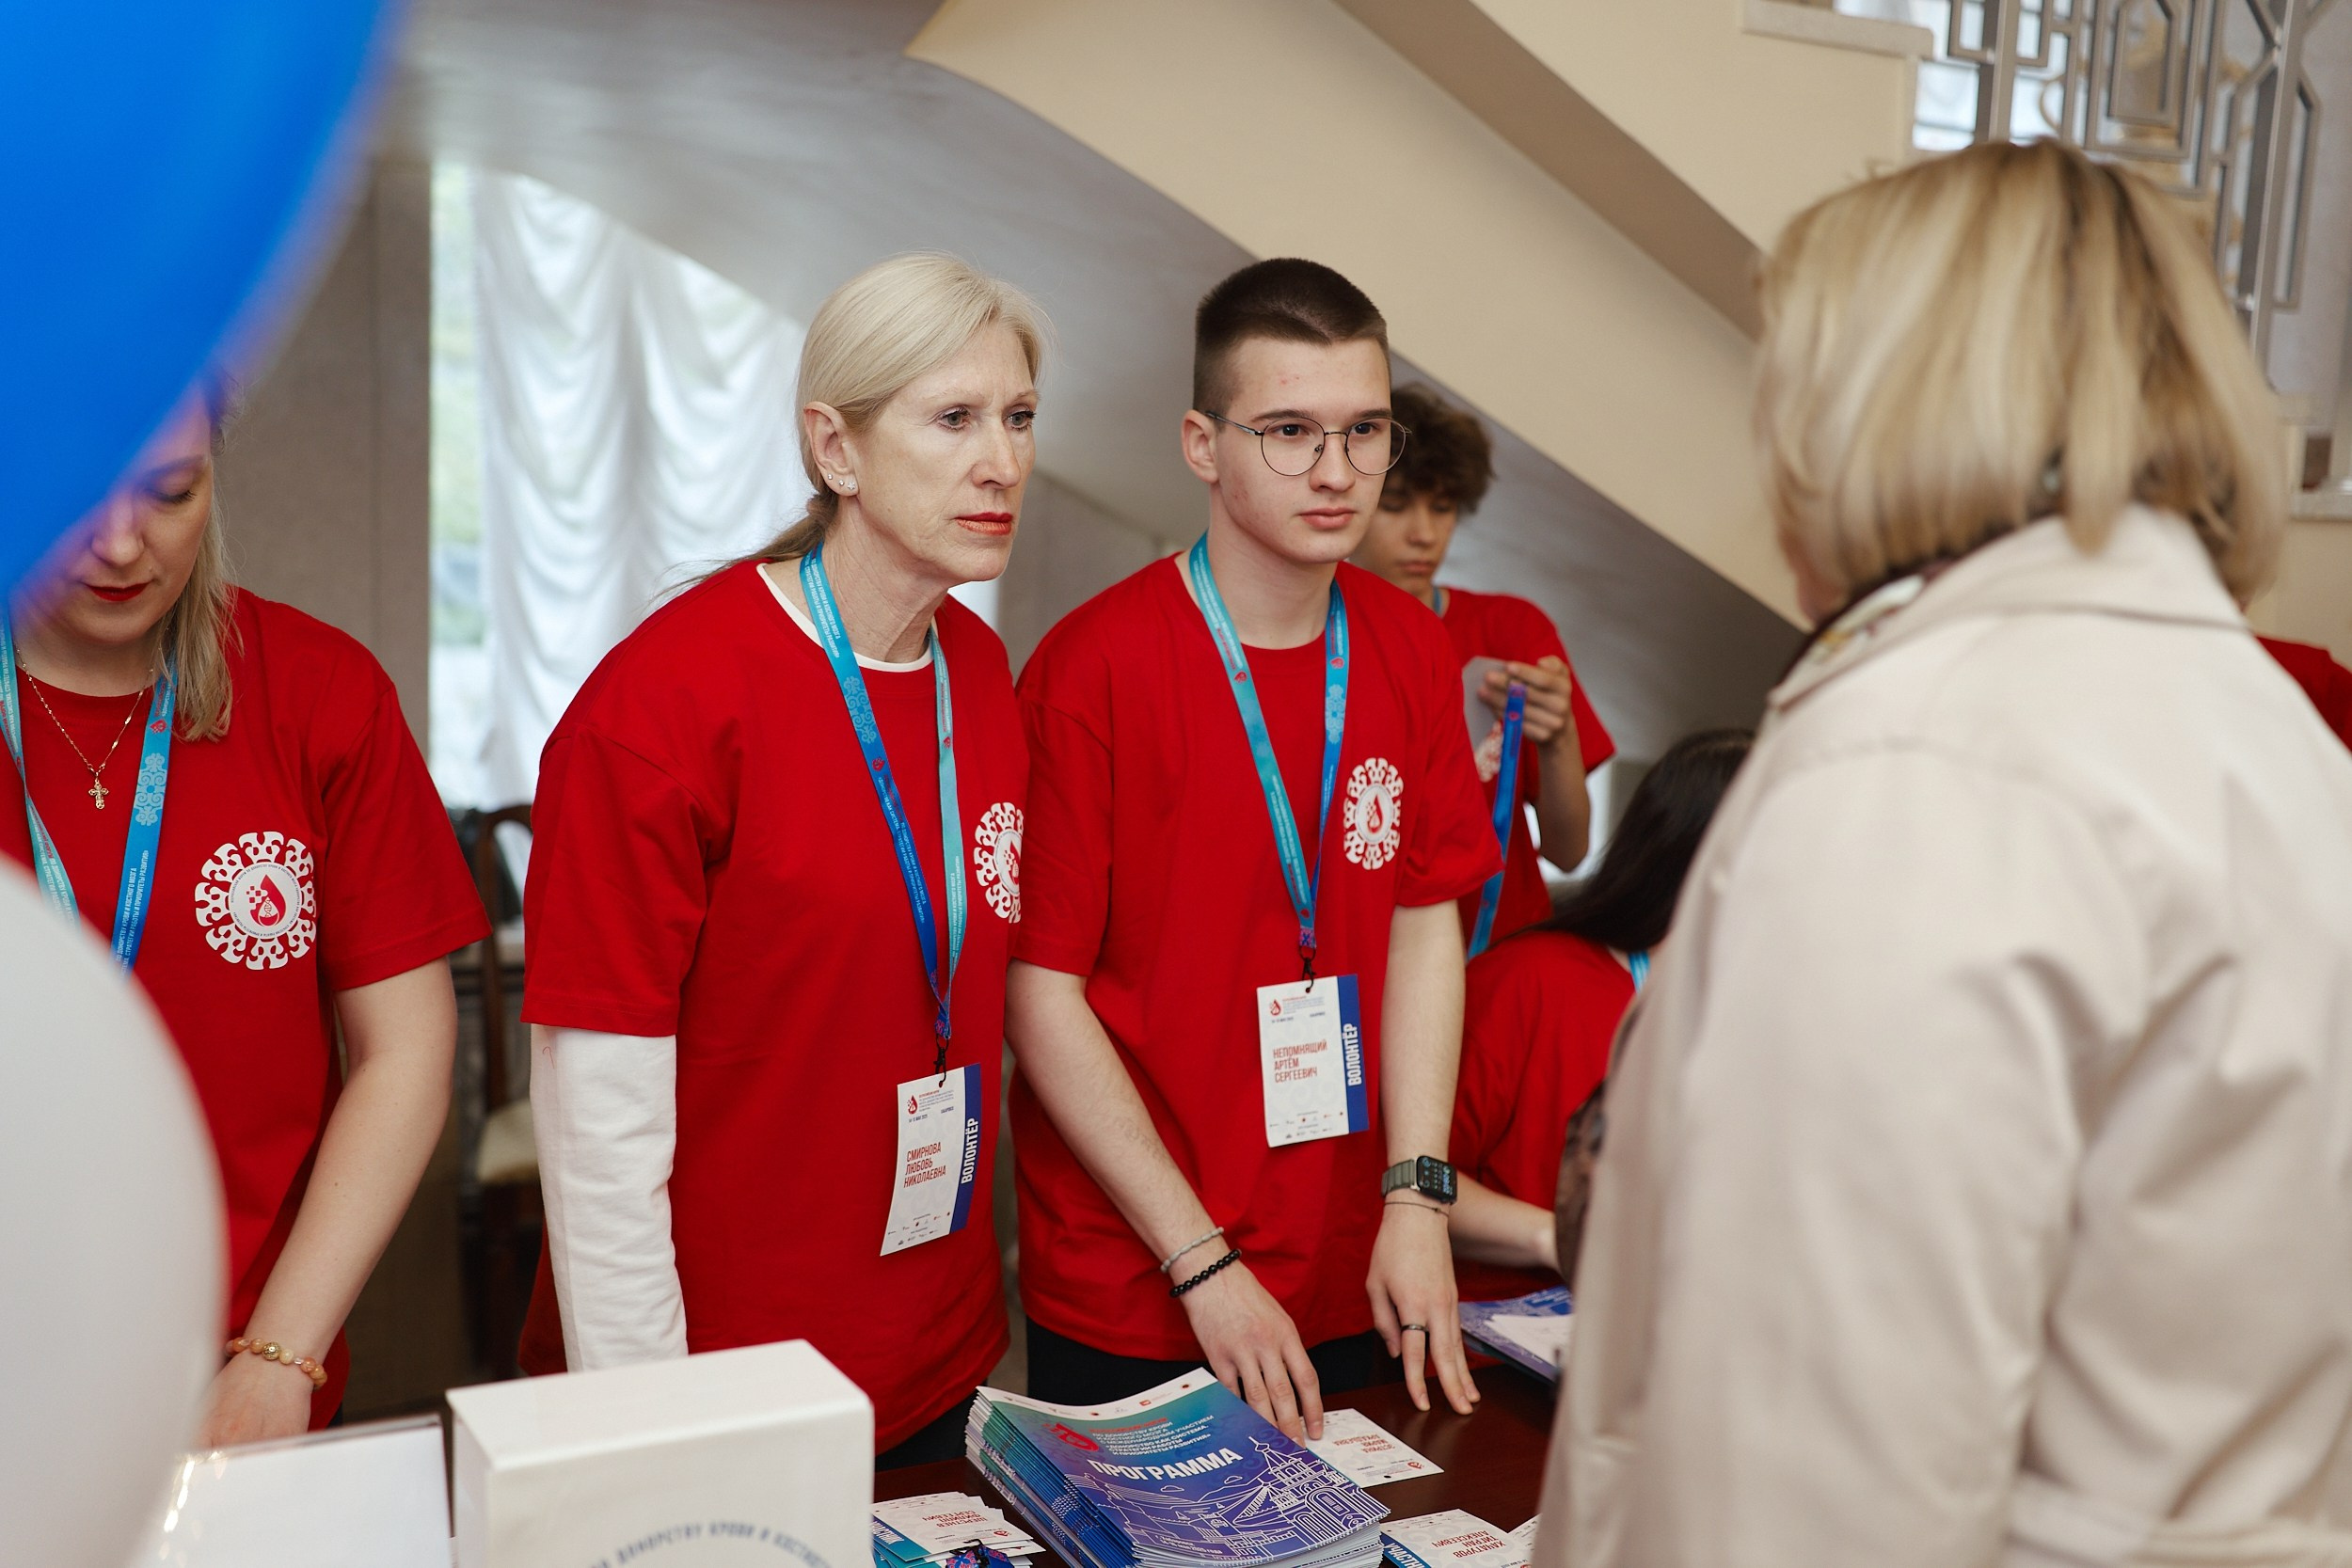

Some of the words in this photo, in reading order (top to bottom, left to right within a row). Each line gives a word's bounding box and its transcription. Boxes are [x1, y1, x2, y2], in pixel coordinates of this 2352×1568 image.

[127, 866, 138, 883] МОЗГА
[123, 882, 135, 907] КОСТНОГО
[132, 875, 146, 906] ПРИОРИТЕТЫ
[120, 910, 131, 927] КРОВИ
[128, 910, 139, 929] РАБОТЫ
[115, 926, 128, 954] ДОНОРСТВУ
[122, 928, 135, 956] СТРАТЕГИИ
[1273, 1039, 1327, 1058] НЕПОМНЯЩИЙ
[1343, 1022, 1362, 1086] ВОЛОНТЁР
[1274, 1056, 1299, 1070] АРТЁМ
[1275, 1068, 1317, 1083] СЕРГЕЕВИЧ
[907, 1142, 942, 1163] СМИРНОВА
[961, 1117, 979, 1184] ВОЛОНТЁР
[905, 1158, 933, 1176] ЛЮБОВЬ
[903, 1170, 946, 1188] НИКОЛАЕВНА
[1176, 1415, 1215, 1433] УЧАСТИЕМ
[1087, 1448, 1244, 1480] ПРОГРАММА
[922, 1510, 976, 1522] СЕРГЕЕВИЧ
[1431, 1530, 1489, 1548] АЛЕКСЕЕВИЧ
[1461, 1535, 1499, 1547] ТИГРАН
[1384, 1543, 1425, 1568] УЧАСТН
[1453, 1540, 1506, 1559] ХАЧАТУРОВ
